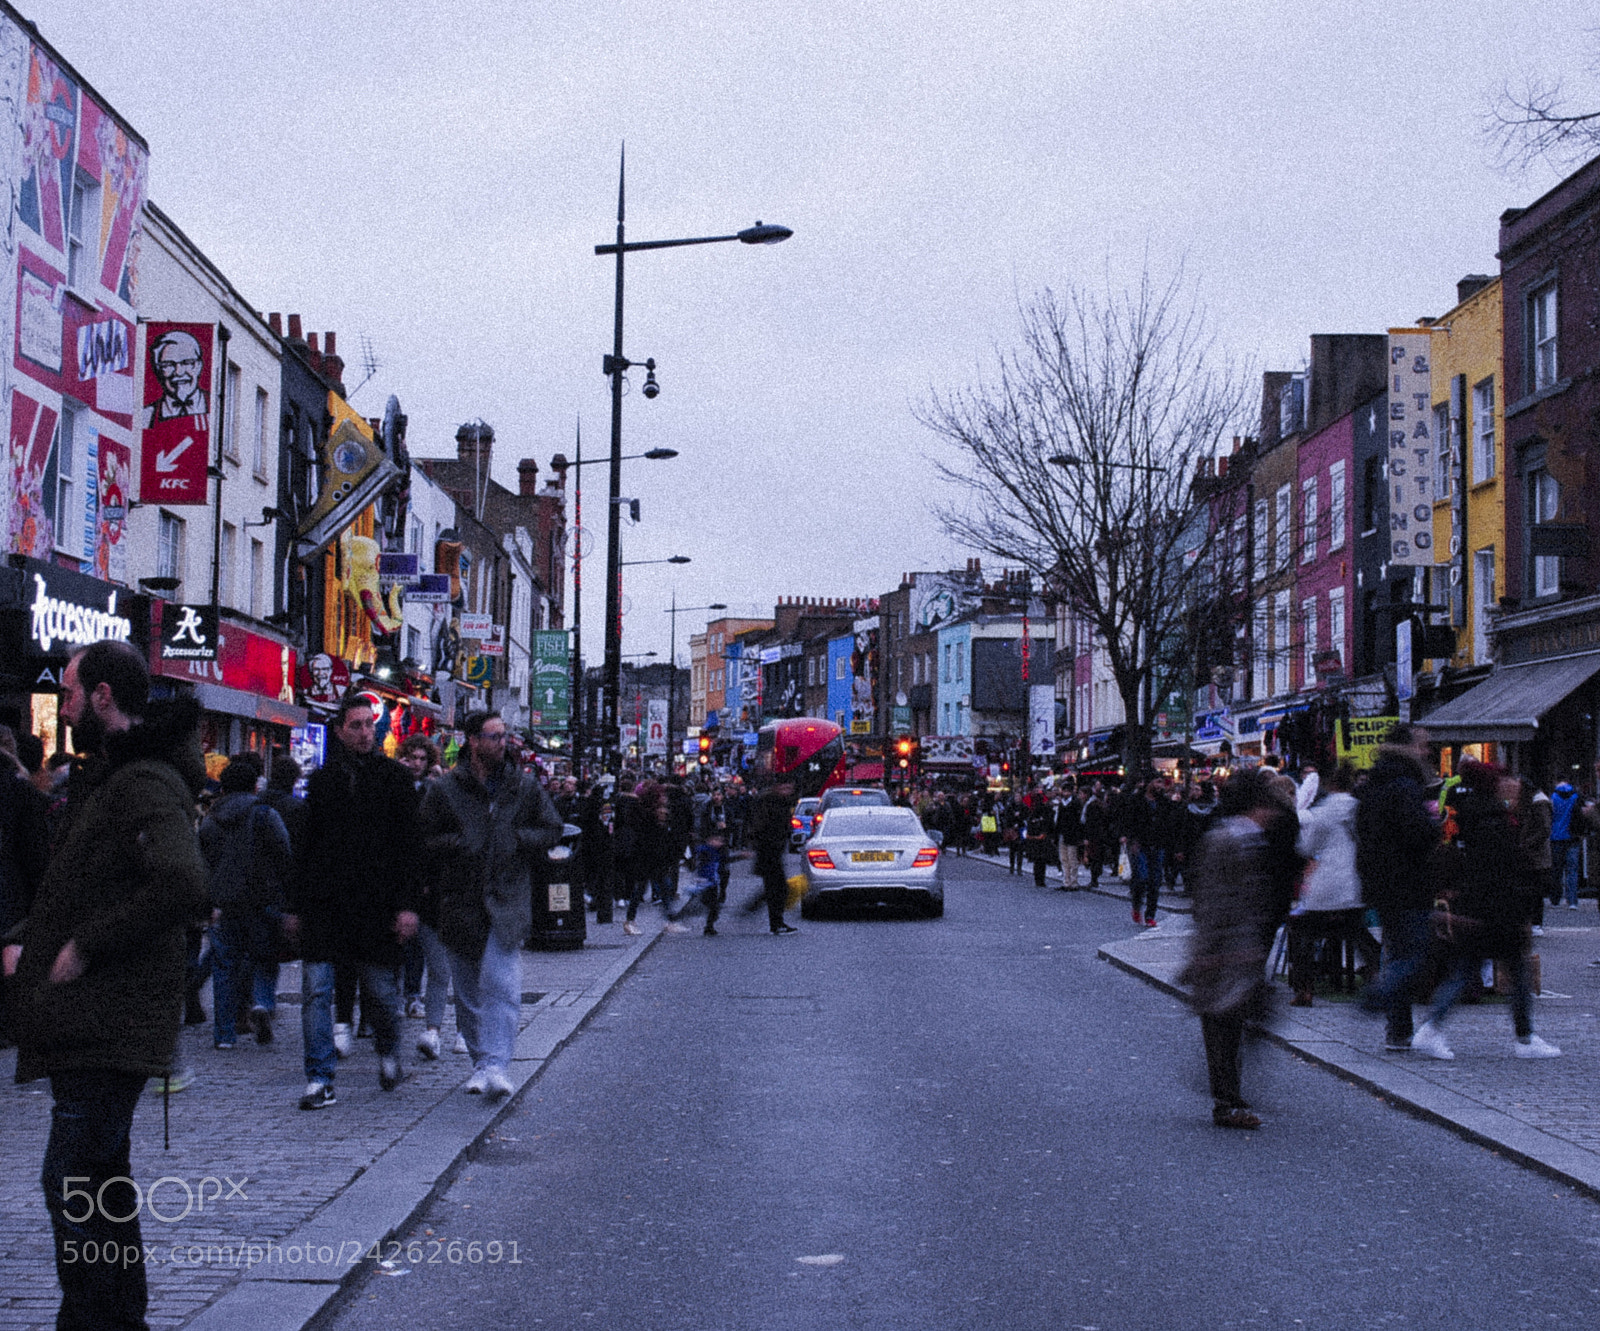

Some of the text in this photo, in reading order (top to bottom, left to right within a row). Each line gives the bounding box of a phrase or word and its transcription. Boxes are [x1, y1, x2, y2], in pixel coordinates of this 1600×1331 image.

[1391, 346, 1410, 558] PIERCING
[1412, 355, 1432, 549] & TATTOO
[159, 478, 190, 489] KFC
[31, 573, 131, 651] Accessorize
[162, 645, 214, 657] Accessorize
[537, 640, 566, 651] FISH
[808, 763, 820, 771] 24
